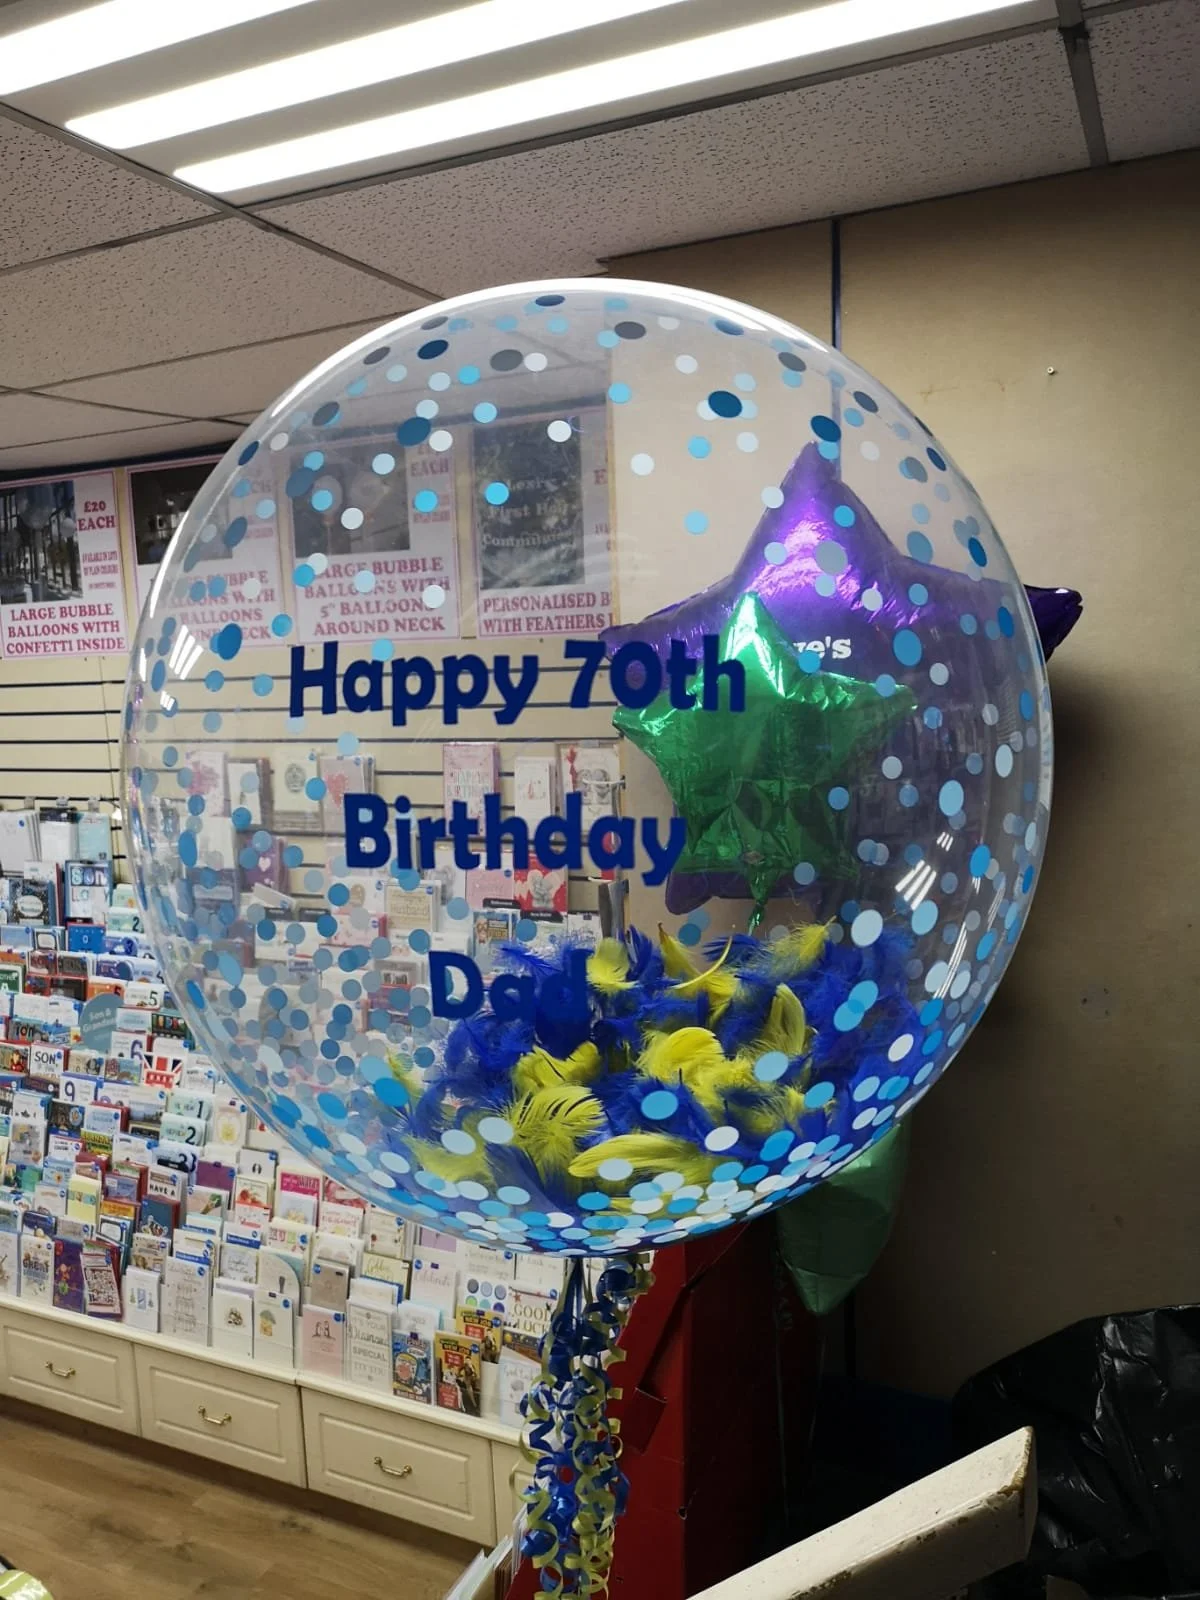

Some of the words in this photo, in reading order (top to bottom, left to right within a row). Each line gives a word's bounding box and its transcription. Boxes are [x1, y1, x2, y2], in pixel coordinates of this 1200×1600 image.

[84, 500, 106, 513] £20
[78, 515, 116, 532] EACH
[312, 561, 367, 580] ARGE
[372, 556, 443, 576] BUBBLE
[304, 578, 397, 599] BALLONS
[340, 596, 435, 616] BALLOON
[483, 591, 597, 613] PERSONALISED
[11, 606, 56, 622] LARGE
[59, 603, 114, 619] BUBBLE
[483, 617, 521, 633] WITH
[526, 612, 605, 632] FEATHERS
[8, 622, 79, 639] BALLOONS
[82, 620, 120, 634] WITH
[314, 618, 390, 637] AROUND
[394, 616, 446, 633] NECK
[6, 639, 74, 655] CONFETTI
[76, 636, 126, 652] INSIDE
[290, 640, 538, 725] Happy
[565, 634, 746, 713] 70th
[344, 790, 686, 886] Birthday
[132, 916, 140, 932] 2
[429, 948, 594, 1020] Dad
[148, 990, 158, 1006] 5
[65, 1081, 76, 1102] 9
[185, 1126, 196, 1146] 2
